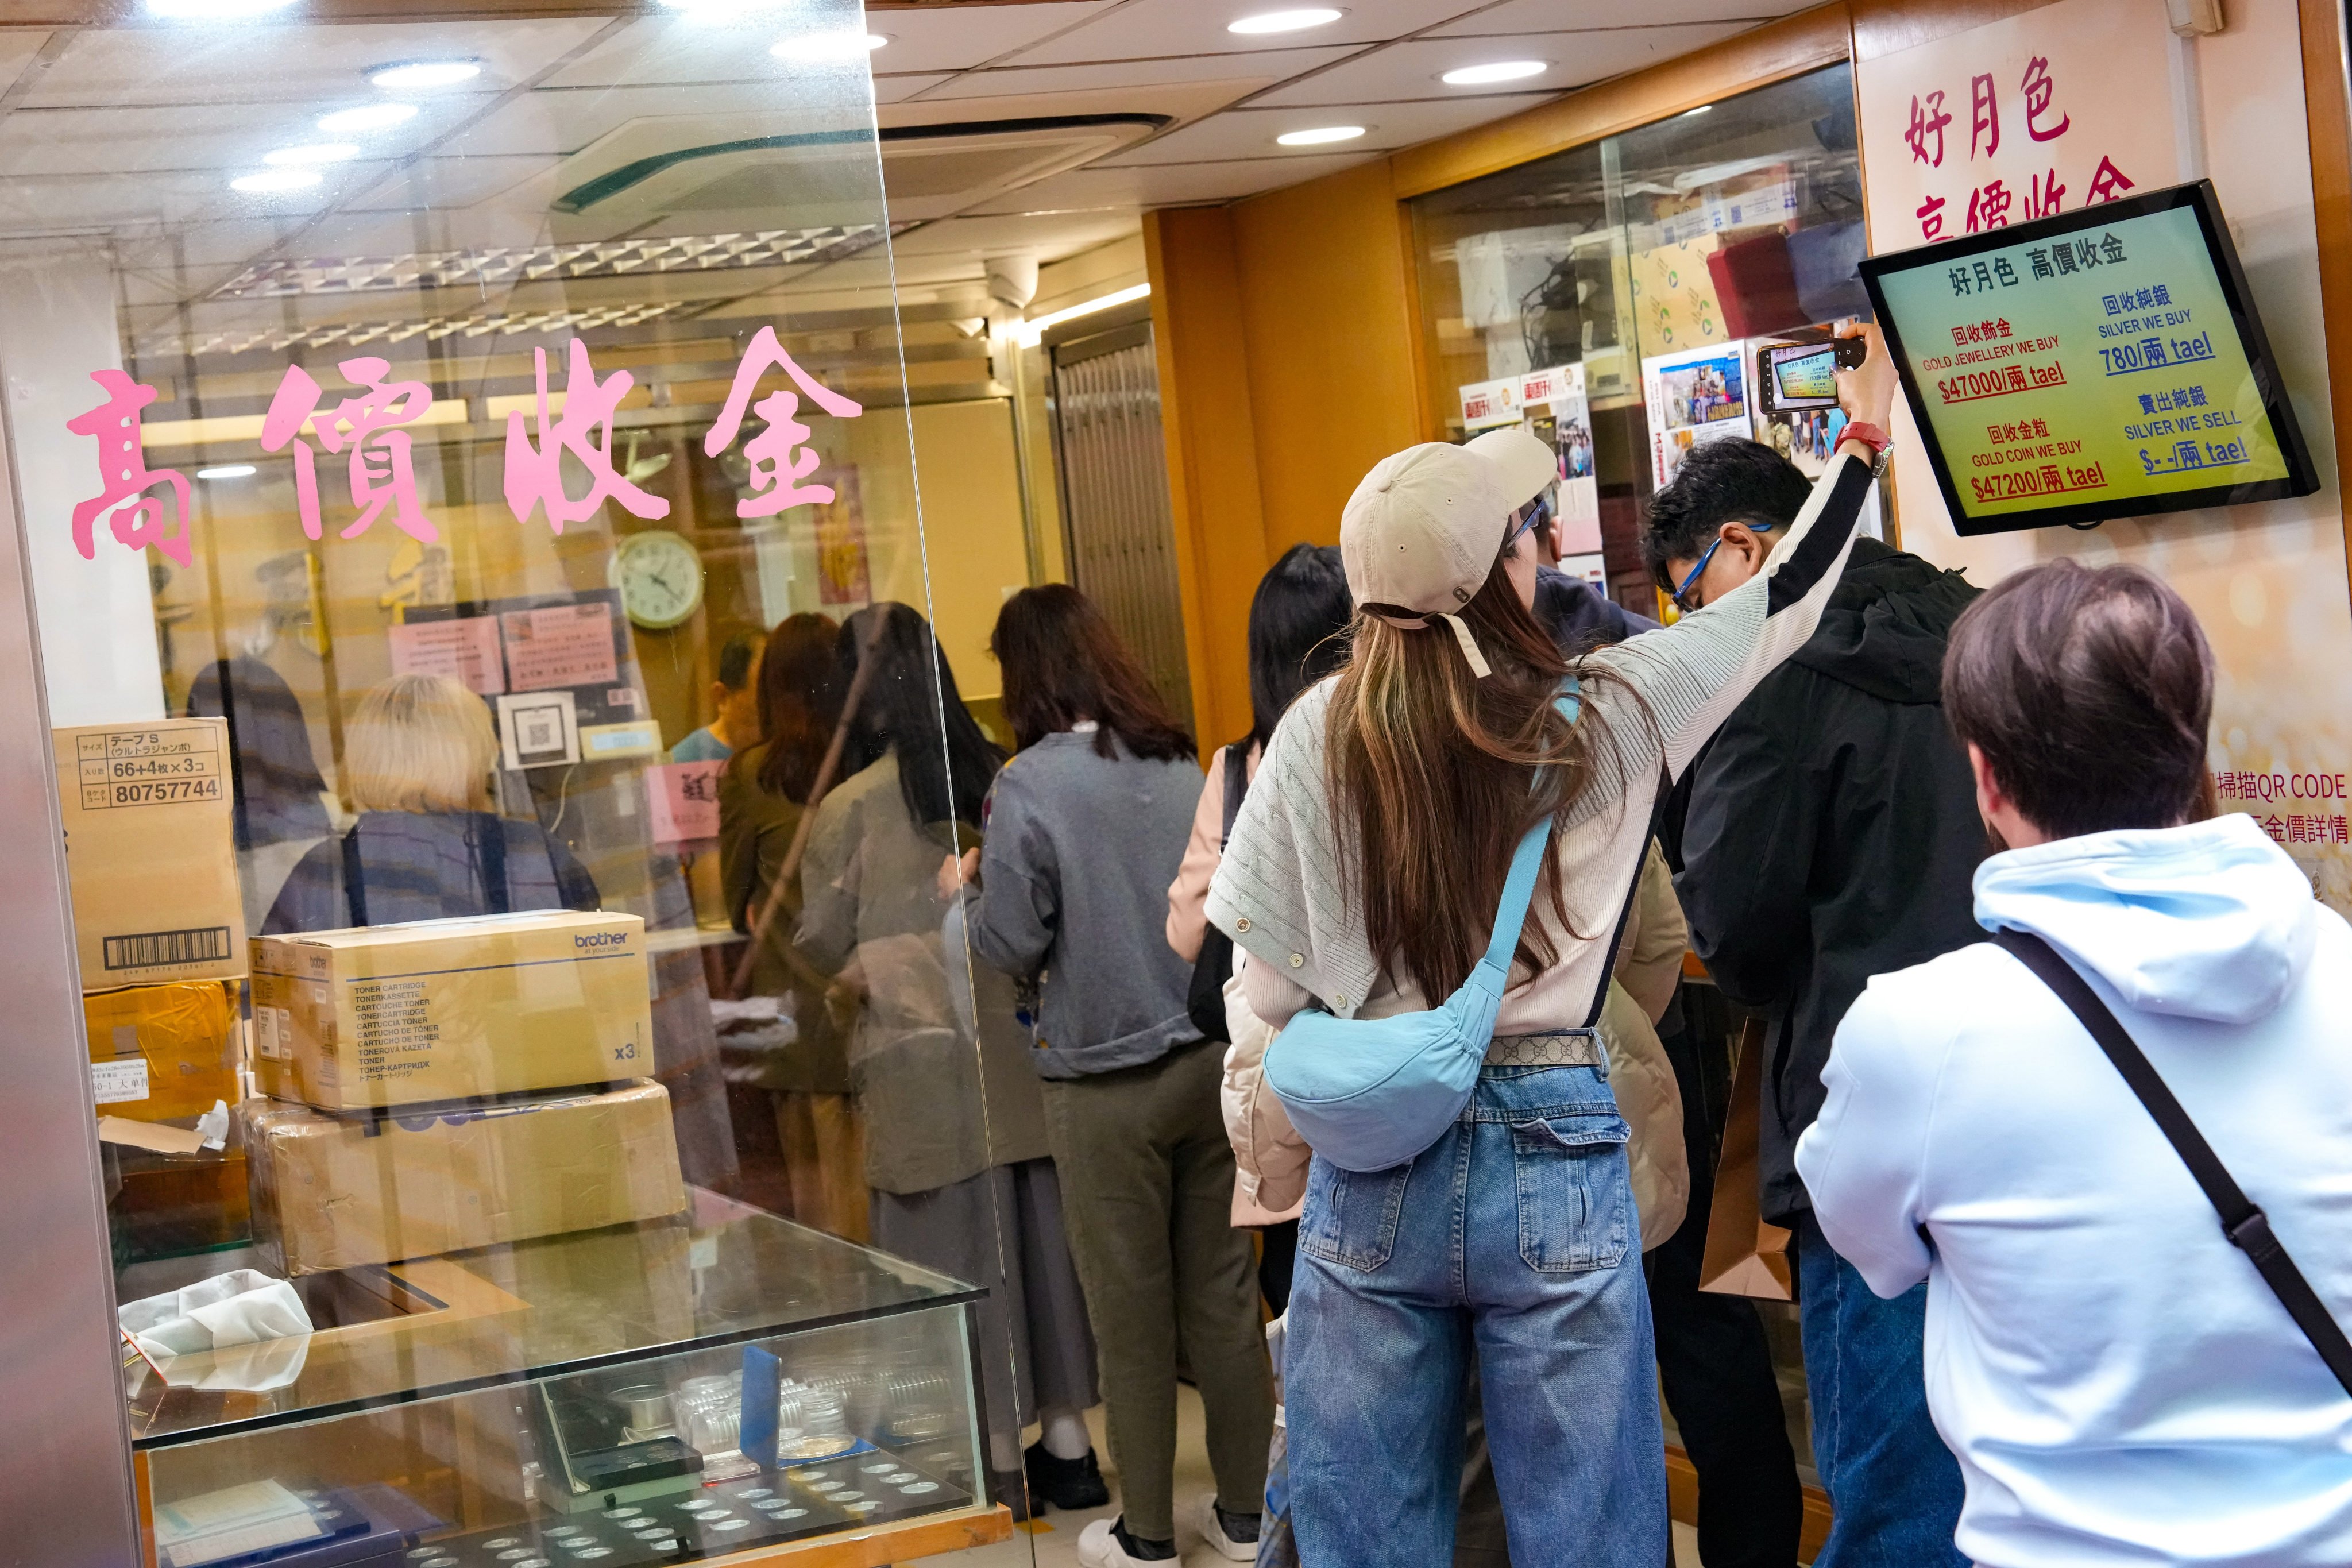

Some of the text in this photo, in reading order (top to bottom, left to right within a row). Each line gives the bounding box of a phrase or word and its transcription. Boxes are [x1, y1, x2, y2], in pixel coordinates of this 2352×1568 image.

[1904, 56, 2071, 168] 好月色
[1948, 232, 2127, 297] 好月色 高價收金
[2102, 284, 2172, 316] 回收純銀
[1951, 318, 2013, 347] 回收飾金
[2098, 308, 2191, 338] SILVER WE BUY
[1923, 335, 2060, 372] GOLD JEWELLERY WE BUY
[2099, 331, 2213, 372] 780/兩 tael
[1938, 360, 2065, 402] $47000/兩 tael
[2137, 385, 2208, 415] 賣出純銀
[1987, 418, 2050, 446] 回收金粒
[2124, 410, 2242, 441] SILVER WE SELL
[66, 325, 863, 569] 高價收金
[1972, 440, 2081, 467] GOLD COIN WE BUY
[2206, 436, 2247, 462] tael
[1971, 461, 2105, 500] $47200/兩 tael
[82, 743, 102, 751] サイズ
[111, 734, 159, 747] テープ S
[84, 768, 105, 776] 入り数
[116, 779, 218, 803] 80757744
[2210, 771, 2347, 803] 掃描QR CODE
[575, 932, 628, 948] brother
[593, 947, 607, 955] your
[310, 955, 326, 970] brother
[355, 982, 426, 994] TONER CARTRIDGE
[355, 991, 420, 1003] TONERKASSETTE
[356, 999, 430, 1012] CARTOUCHE TONER
[357, 1008, 426, 1021] TONERCARTRIDGE
[357, 1017, 428, 1030] CARTUCCIA TONER
[357, 1028, 399, 1038] CARTUCHO
[413, 1024, 439, 1032] TÓNER
[358, 1038, 400, 1048] CARTUCHO
[414, 1033, 439, 1041] TONER
[358, 1043, 431, 1056] TONEROVÁ KAZETA
[359, 1057, 385, 1065] TONER
[615, 1043, 635, 1060] x3
[360, 1061, 430, 1074] ТОНЕР-КАРТРИДЖ
